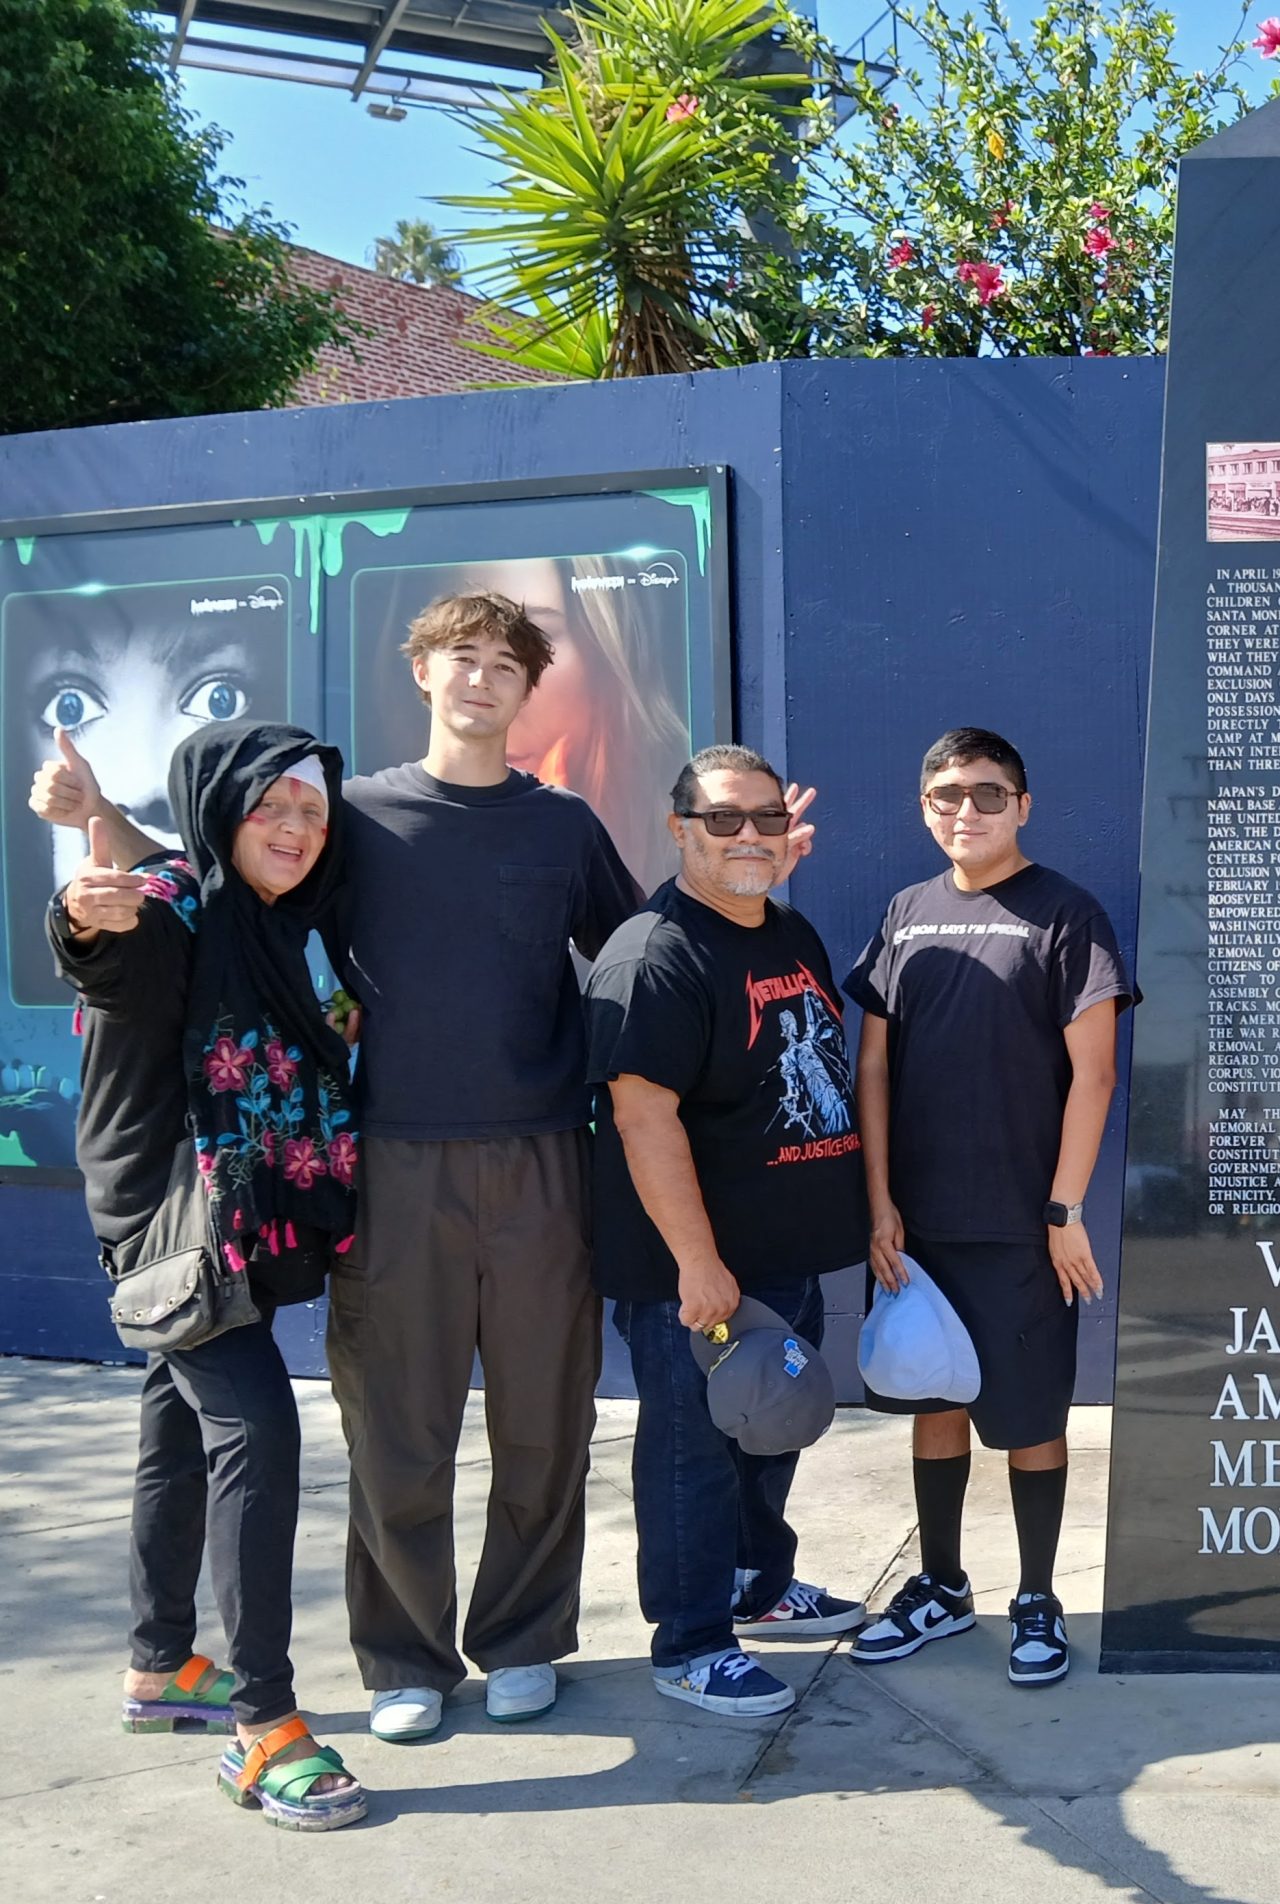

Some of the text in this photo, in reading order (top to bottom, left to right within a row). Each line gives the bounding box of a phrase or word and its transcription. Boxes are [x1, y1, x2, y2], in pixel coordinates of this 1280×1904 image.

[1217, 569, 1230, 579] IN
[1234, 568, 1268, 579] APRIL
[1207, 583, 1215, 593] A
[1207, 596, 1270, 607] CHILDREN
[1207, 610, 1246, 621] SANTA
[1207, 625, 1257, 635] CORNER
[1264, 624, 1279, 635] AT
[1207, 638, 1240, 649] THEY
[1244, 638, 1279, 648] WERE
[1207, 652, 1242, 662] WHAT
[1246, 651, 1278, 662] THEY
[1207, 665, 1271, 676] COMMAND
[1208, 679, 1272, 689] EXCLUSION
[1207, 693, 1238, 703] ONLY
[1245, 692, 1275, 702] DAYS
[1208, 719, 1269, 730] DIRECTLY
[1207, 733, 1242, 743] CAMP
[1249, 732, 1264, 743] AT
[1208, 747, 1244, 756] MANY
[1207, 760, 1242, 770] THAN
[939, 923, 967, 936] SAYS
[1208, 948, 1265, 957] REMOVAL
[745, 959, 844, 1050] METALLICA
[1208, 1014, 1232, 1024] TEN
[1208, 1041, 1264, 1051] REMOVAL
[1219, 1108, 1246, 1119] MAY
[800, 1138, 843, 1160] JUSTICE
[1209, 1203, 1225, 1214] OR
